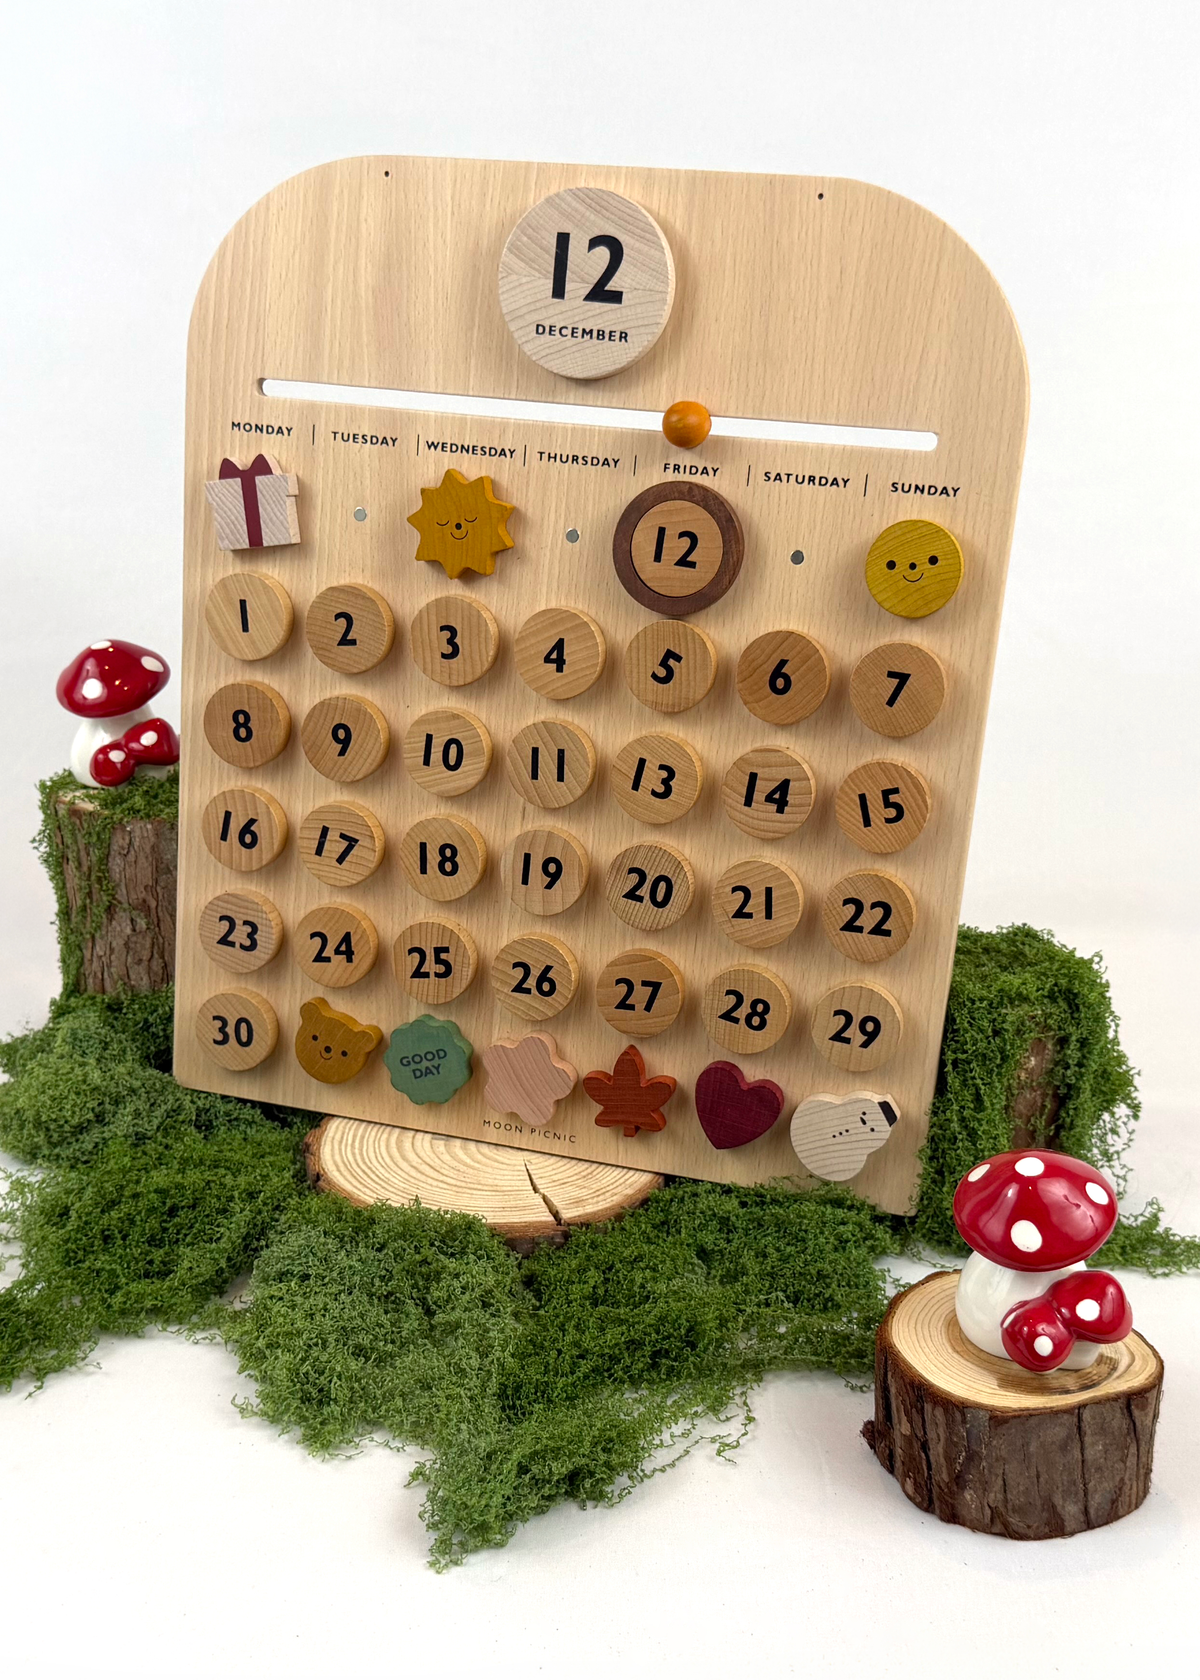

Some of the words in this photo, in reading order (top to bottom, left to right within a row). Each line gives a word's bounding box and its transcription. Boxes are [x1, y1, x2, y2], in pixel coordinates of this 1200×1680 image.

[551, 231, 624, 305] 12
[535, 323, 629, 343] DECEMBER
[231, 421, 293, 437] MONDAY
[331, 431, 398, 447] TUESDAY
[425, 440, 516, 459] WEDNESDAY
[537, 451, 620, 469] THURSDAY
[663, 462, 720, 477] FRIDAY
[763, 471, 851, 489] SATURDAY
[890, 481, 961, 498] SUNDAY
[653, 526, 699, 570] 12
[239, 598, 250, 633] 1
[334, 611, 358, 647] 2
[439, 624, 460, 660] 3
[543, 637, 567, 674] 4
[651, 648, 684, 684] 5
[768, 658, 792, 696] 6
[885, 670, 912, 708] 7
[231, 709, 254, 743] 8
[331, 722, 353, 757] 9
[422, 732, 464, 772] 10
[530, 746, 566, 783] 11
[631, 757, 676, 800] 13
[743, 771, 791, 815] 14
[857, 786, 905, 829] 15
[219, 809, 259, 850] 16
[314, 824, 360, 866] 17
[419, 841, 460, 877] 18
[521, 852, 564, 891] 19
[621, 866, 674, 909] 20
[730, 885, 773, 921] 21
[216, 914, 259, 952] 23
[839, 897, 893, 938] 22
[309, 931, 355, 964] 24
[407, 946, 453, 979] 25
[510, 961, 557, 998] 26
[614, 977, 663, 1013] 27
[717, 990, 770, 1031] 28
[828, 1008, 882, 1049] 29
[212, 1015, 254, 1048] 30
[400, 1049, 447, 1068] GOOD
[412, 1063, 441, 1079] DAY
[483, 1118, 523, 1133] MOON
[530, 1127, 576, 1144] PICNIC
